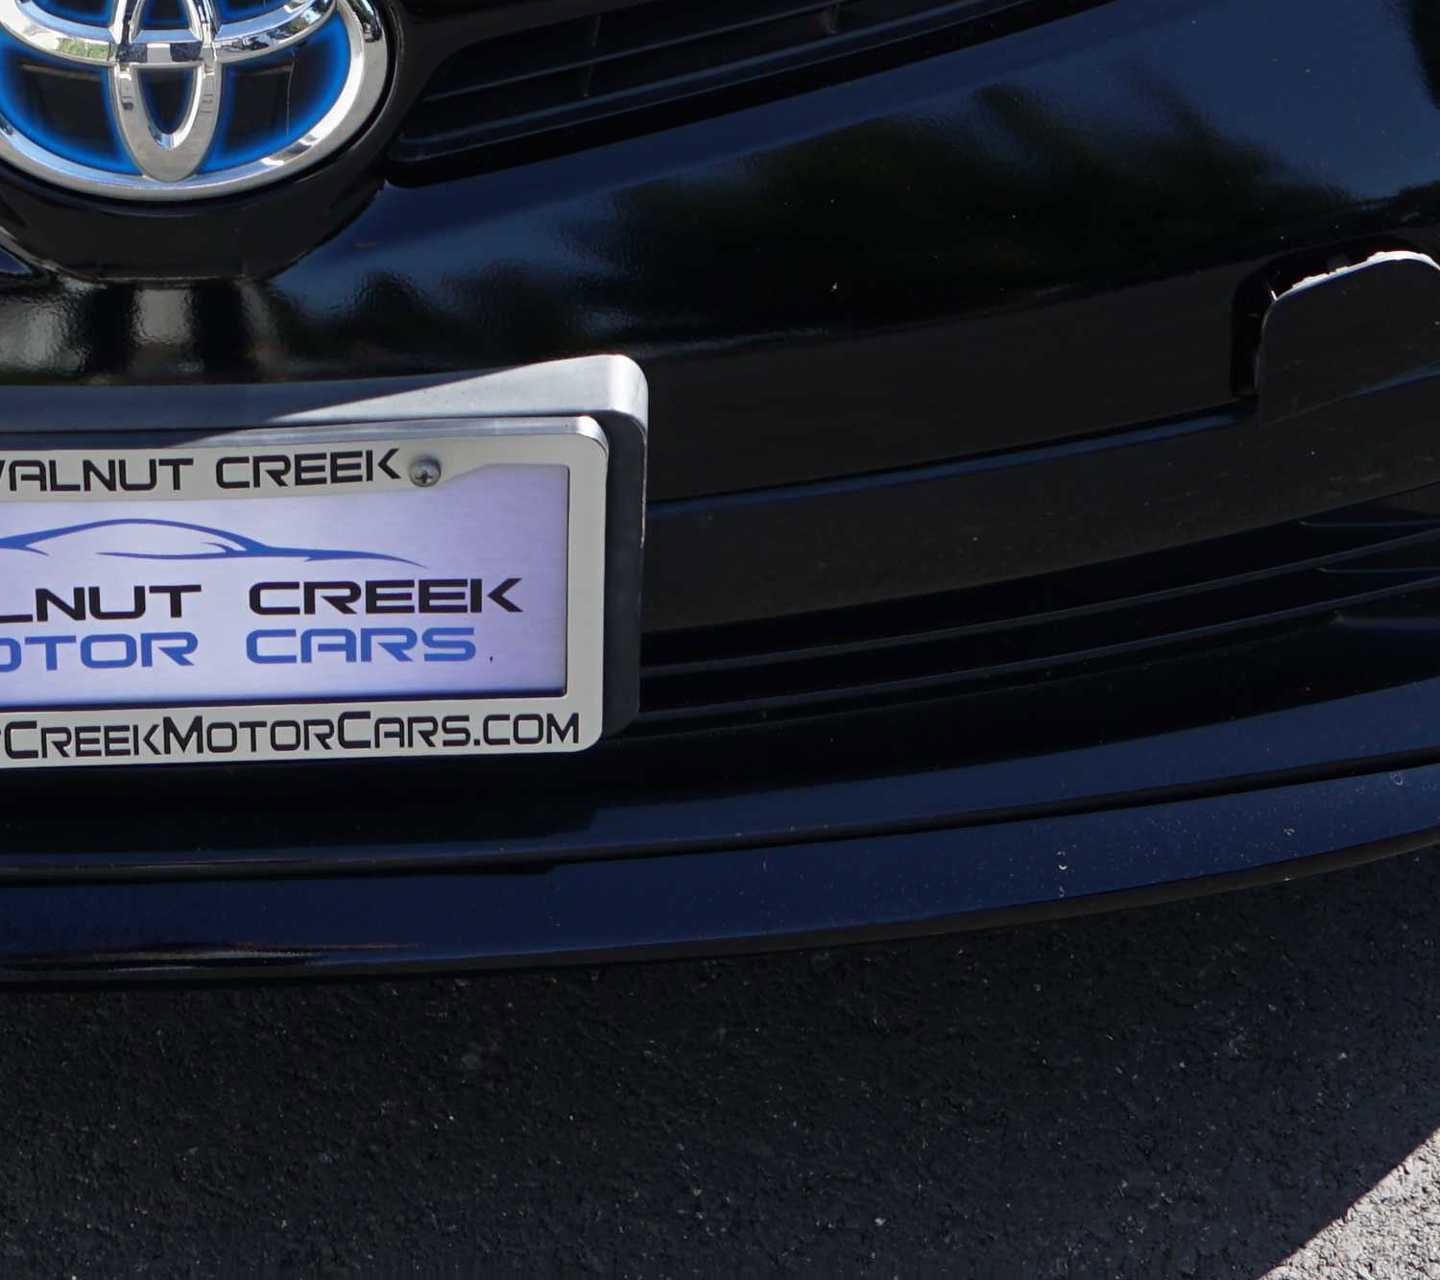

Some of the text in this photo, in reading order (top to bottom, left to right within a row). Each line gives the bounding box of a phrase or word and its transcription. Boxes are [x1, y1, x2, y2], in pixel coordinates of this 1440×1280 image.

[215, 448, 401, 488] CREEK
[248, 577, 522, 616] CREEK
[245, 627, 477, 664] CARS
